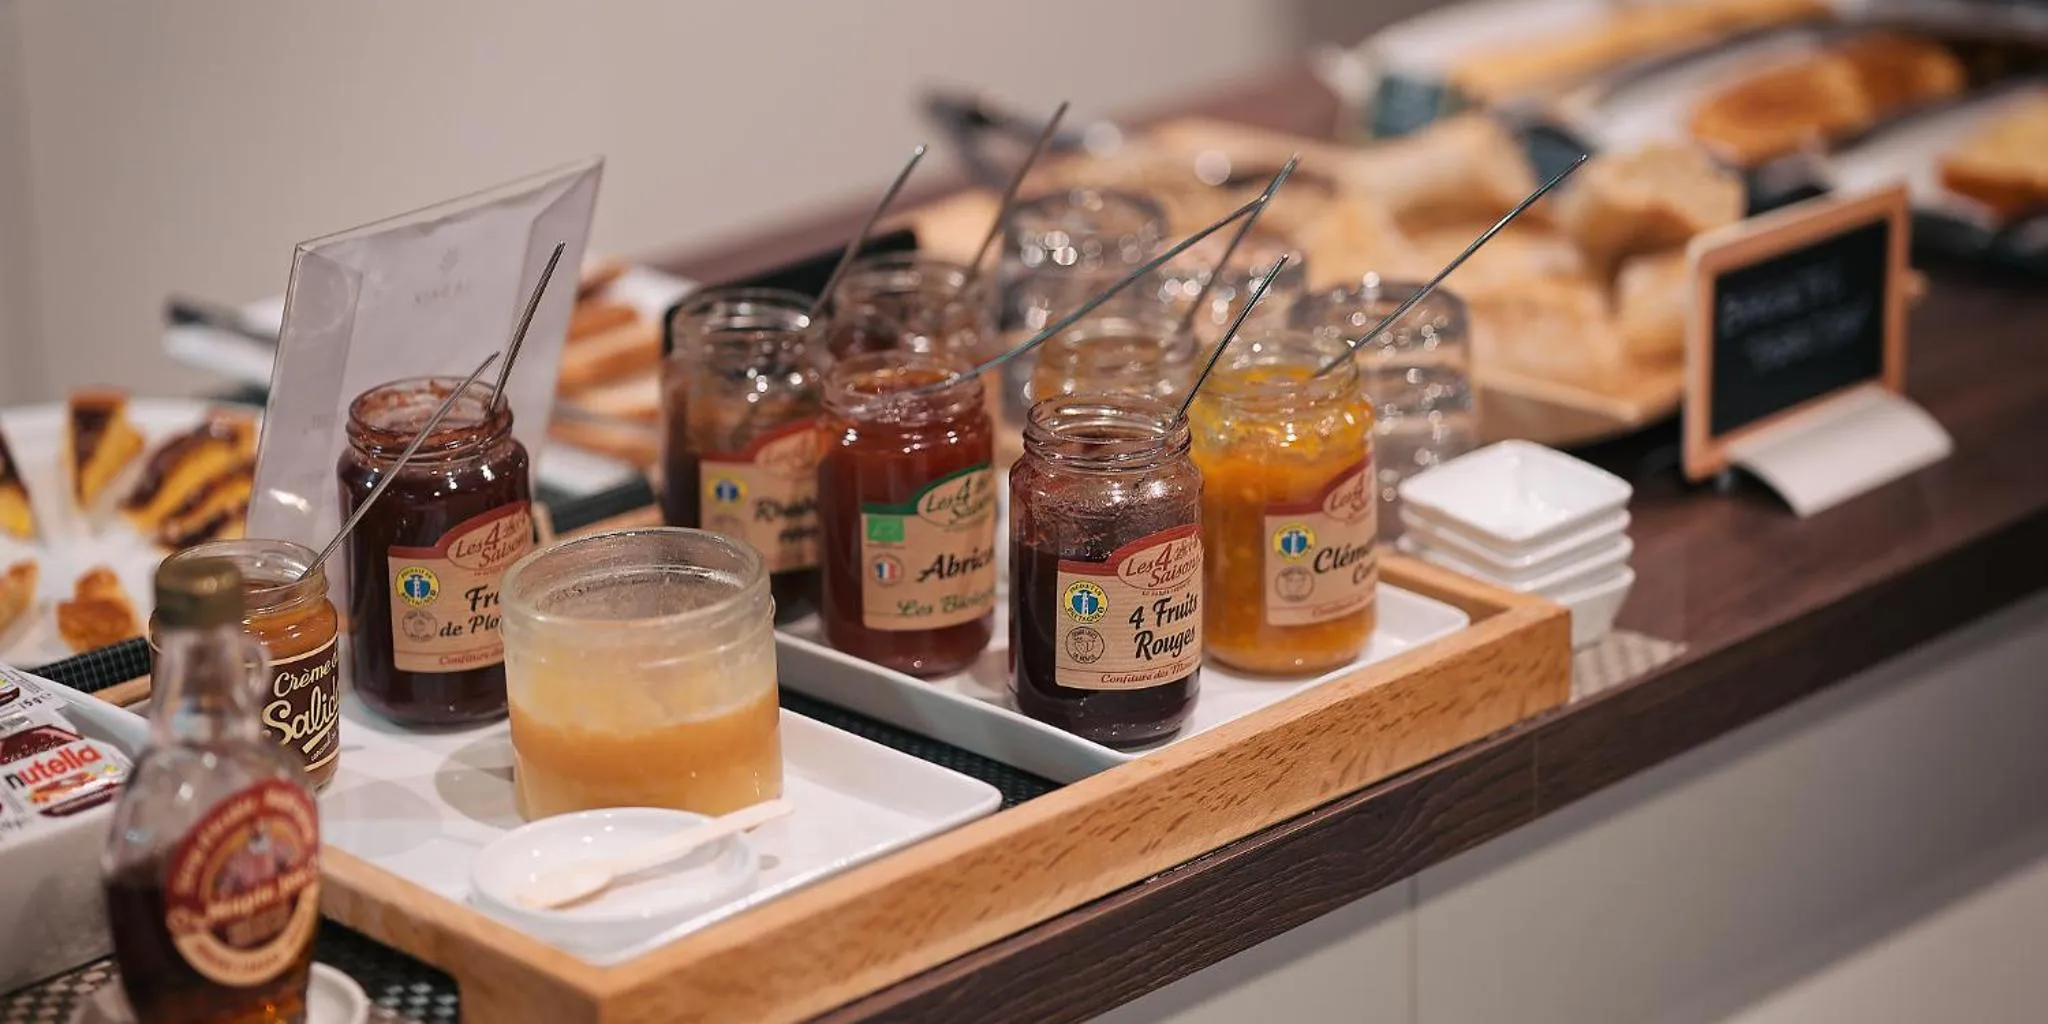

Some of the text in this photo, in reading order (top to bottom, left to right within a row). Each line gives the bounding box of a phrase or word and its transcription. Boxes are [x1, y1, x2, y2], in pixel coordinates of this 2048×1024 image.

[455, 521, 500, 558] Les 4
[1126, 543, 1172, 577] Les 4
[440, 621, 463, 637] de
[1129, 591, 1199, 630] 4 Fruits
[1134, 624, 1196, 661] Rouges
[273, 659, 331, 697] Crème
[1101, 670, 1153, 685] Confiture
[262, 676, 339, 745] Salid
[5, 744, 102, 790] nutella
